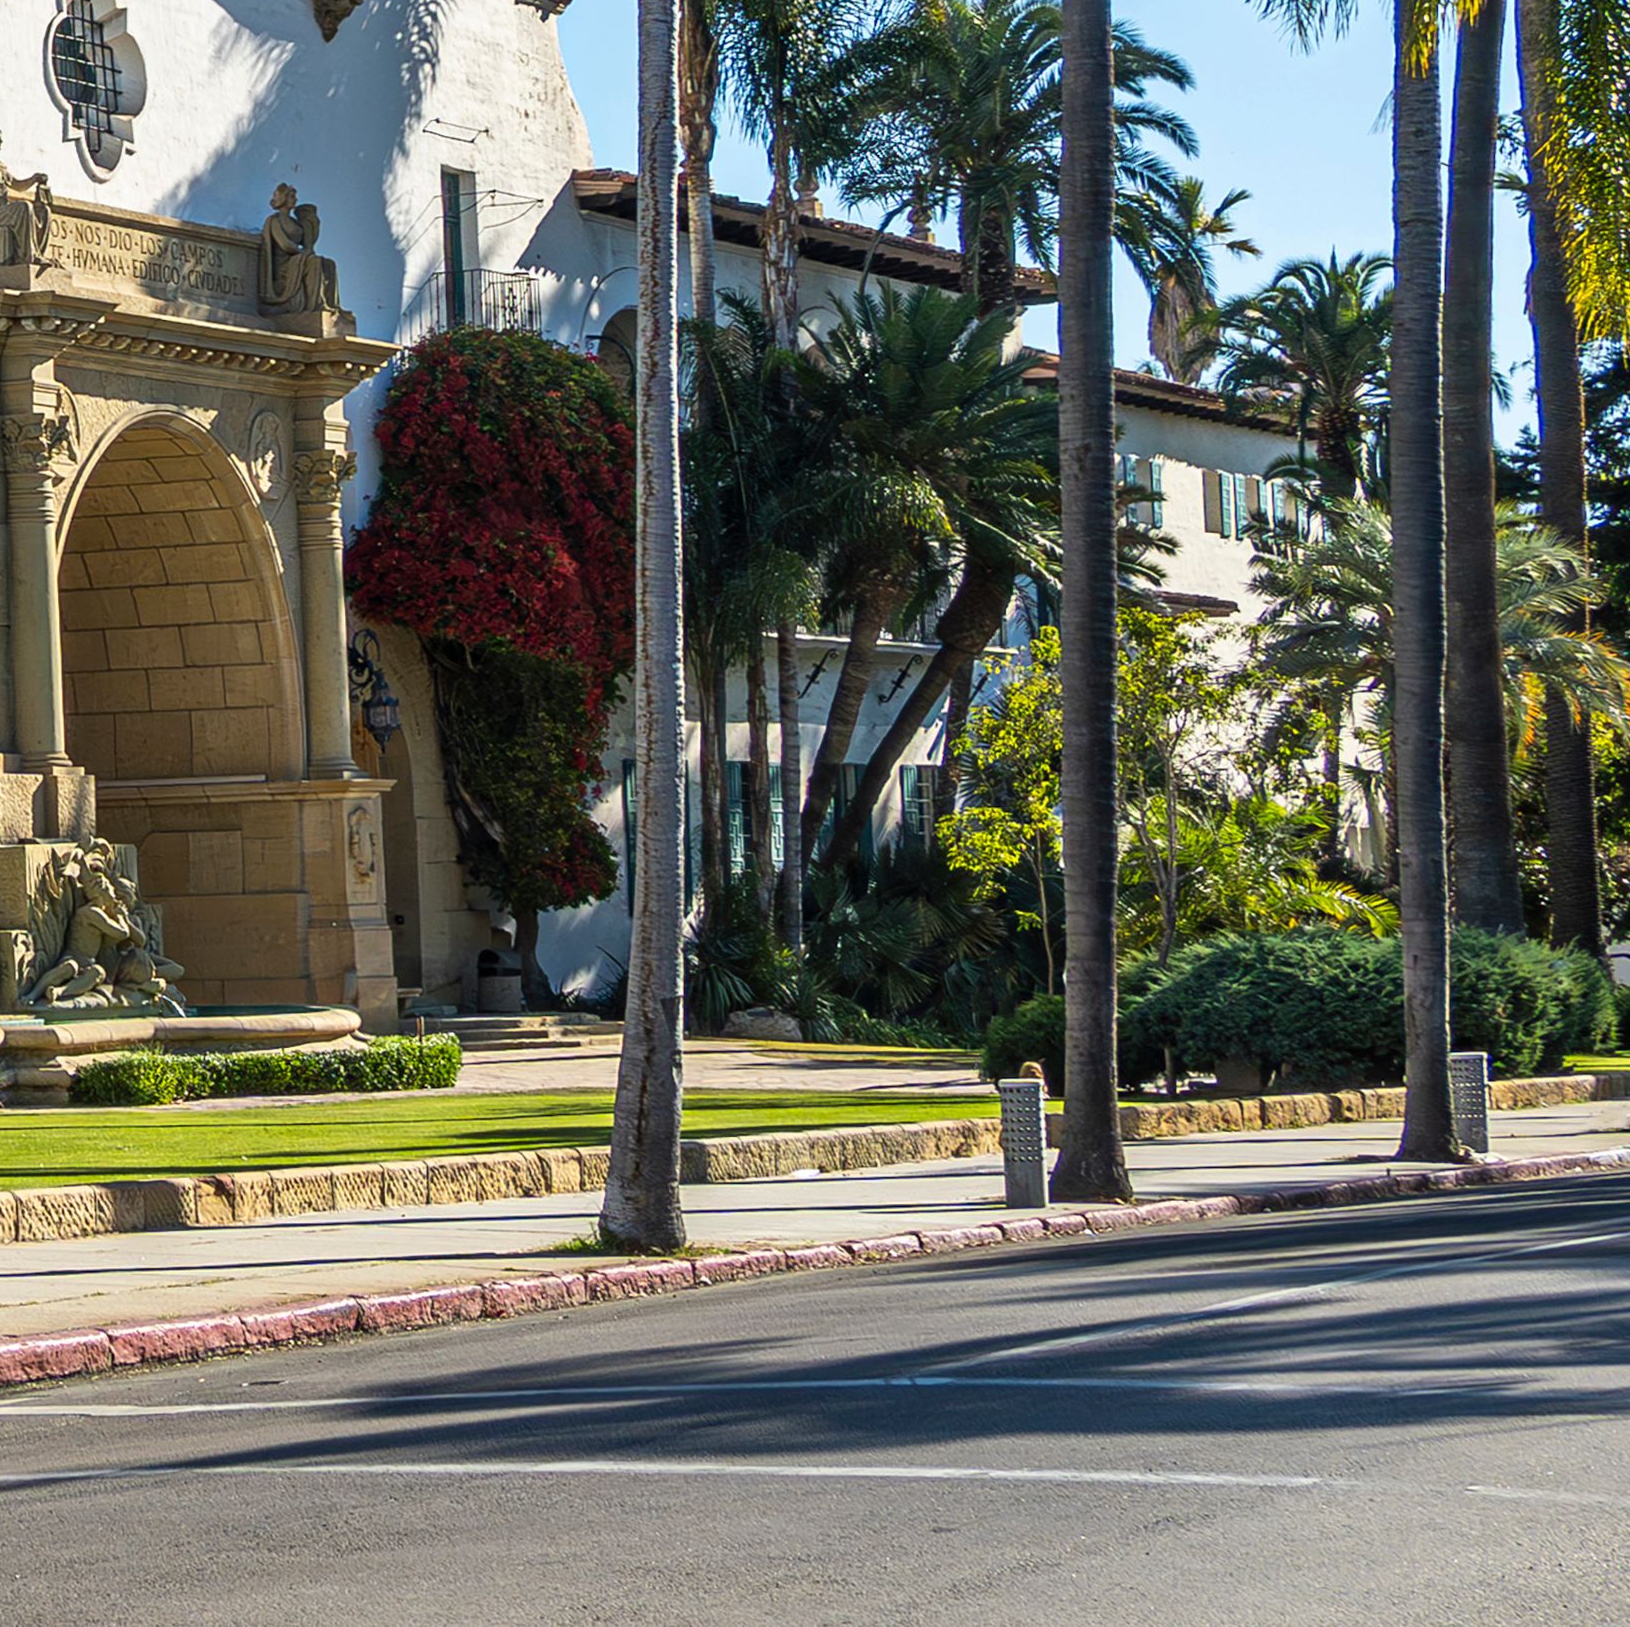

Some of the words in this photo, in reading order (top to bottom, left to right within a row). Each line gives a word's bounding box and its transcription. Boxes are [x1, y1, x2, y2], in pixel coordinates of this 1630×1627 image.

[50, 219, 67, 239] OS
[75, 223, 101, 246] NOS
[109, 229, 132, 251] DIO
[140, 235, 162, 257] LOS
[170, 241, 223, 268] CAMPOS
